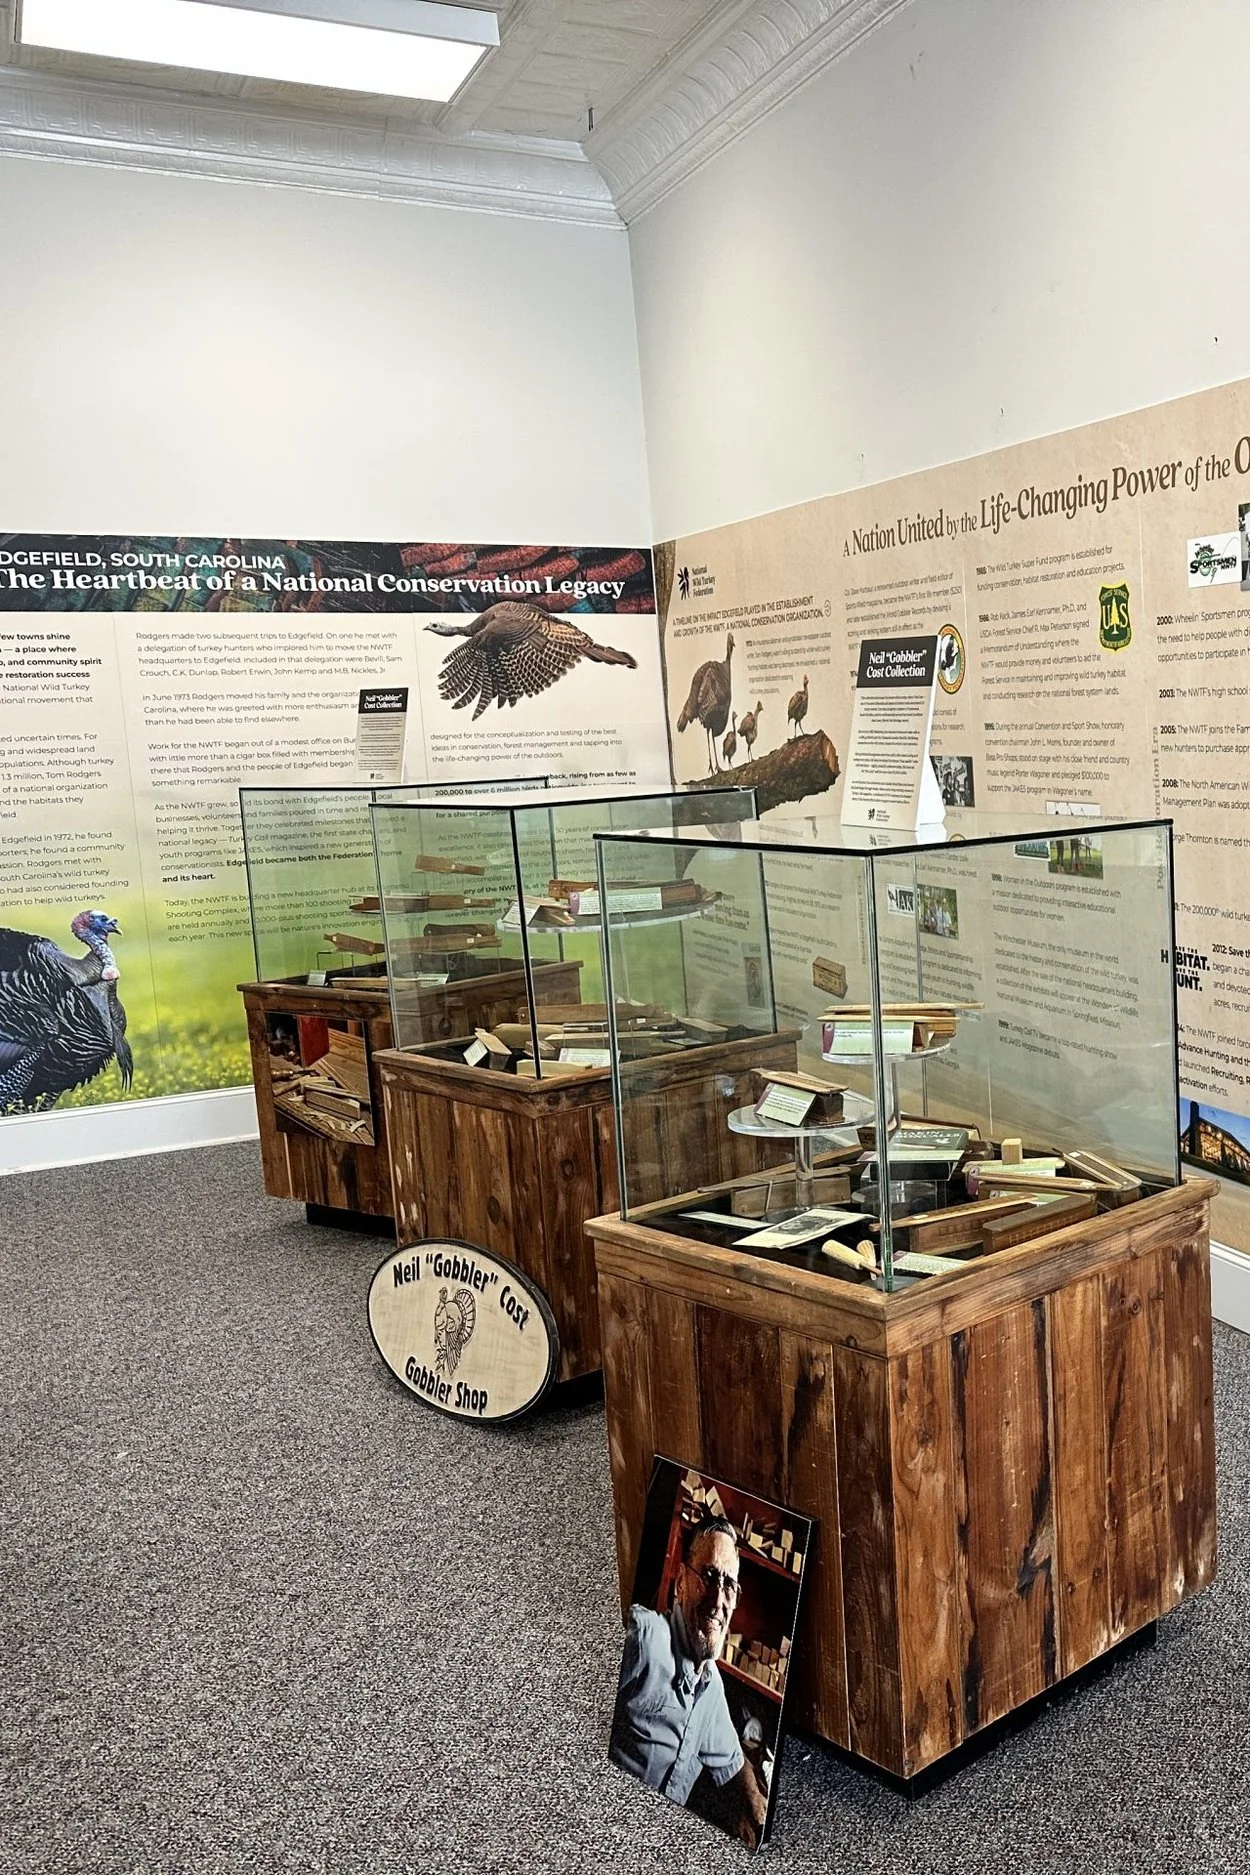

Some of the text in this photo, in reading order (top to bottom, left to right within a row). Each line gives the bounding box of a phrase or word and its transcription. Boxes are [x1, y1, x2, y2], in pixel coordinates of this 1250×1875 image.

[842, 539, 850, 557] A
[852, 524, 896, 555] Nation
[898, 508, 944, 546] United
[946, 516, 958, 540] by
[960, 512, 978, 532] the
[980, 474, 1108, 534] Life-Changing
[1111, 460, 1182, 500] Power
[1184, 456, 1202, 492] of
[1206, 454, 1230, 481] the
[0, 550, 286, 570] DGEFIELD, SOUTH CAROLINA
[0, 568, 626, 599] The Heartbeat of a National Conservation Legacy
[45, 632, 70, 640] shine
[22, 645, 46, 654] place
[26, 657, 78, 666] community
[79, 657, 102, 666] spirit
[869, 650, 927, 664] Neil "Gobbler"
[4, 670, 54, 678] restoration
[866, 664, 926, 679] Cost Collection
[2, 683, 39, 691] National
[61, 682, 90, 691] Turkey
[1175, 688, 1187, 697] The
[1187, 686, 1211, 696] NWTF's
[1211, 687, 1226, 698] high
[1227, 685, 1248, 695] school
[1211, 943, 1227, 954] 2012:
[1228, 945, 1244, 957] Save
[1161, 949, 1210, 970] HBITAT.
[1177, 974, 1202, 991] UNT.
[393, 1253, 530, 1330] Neil "Gobbler" Cost
[405, 1356, 488, 1415] Gobbler Shop
